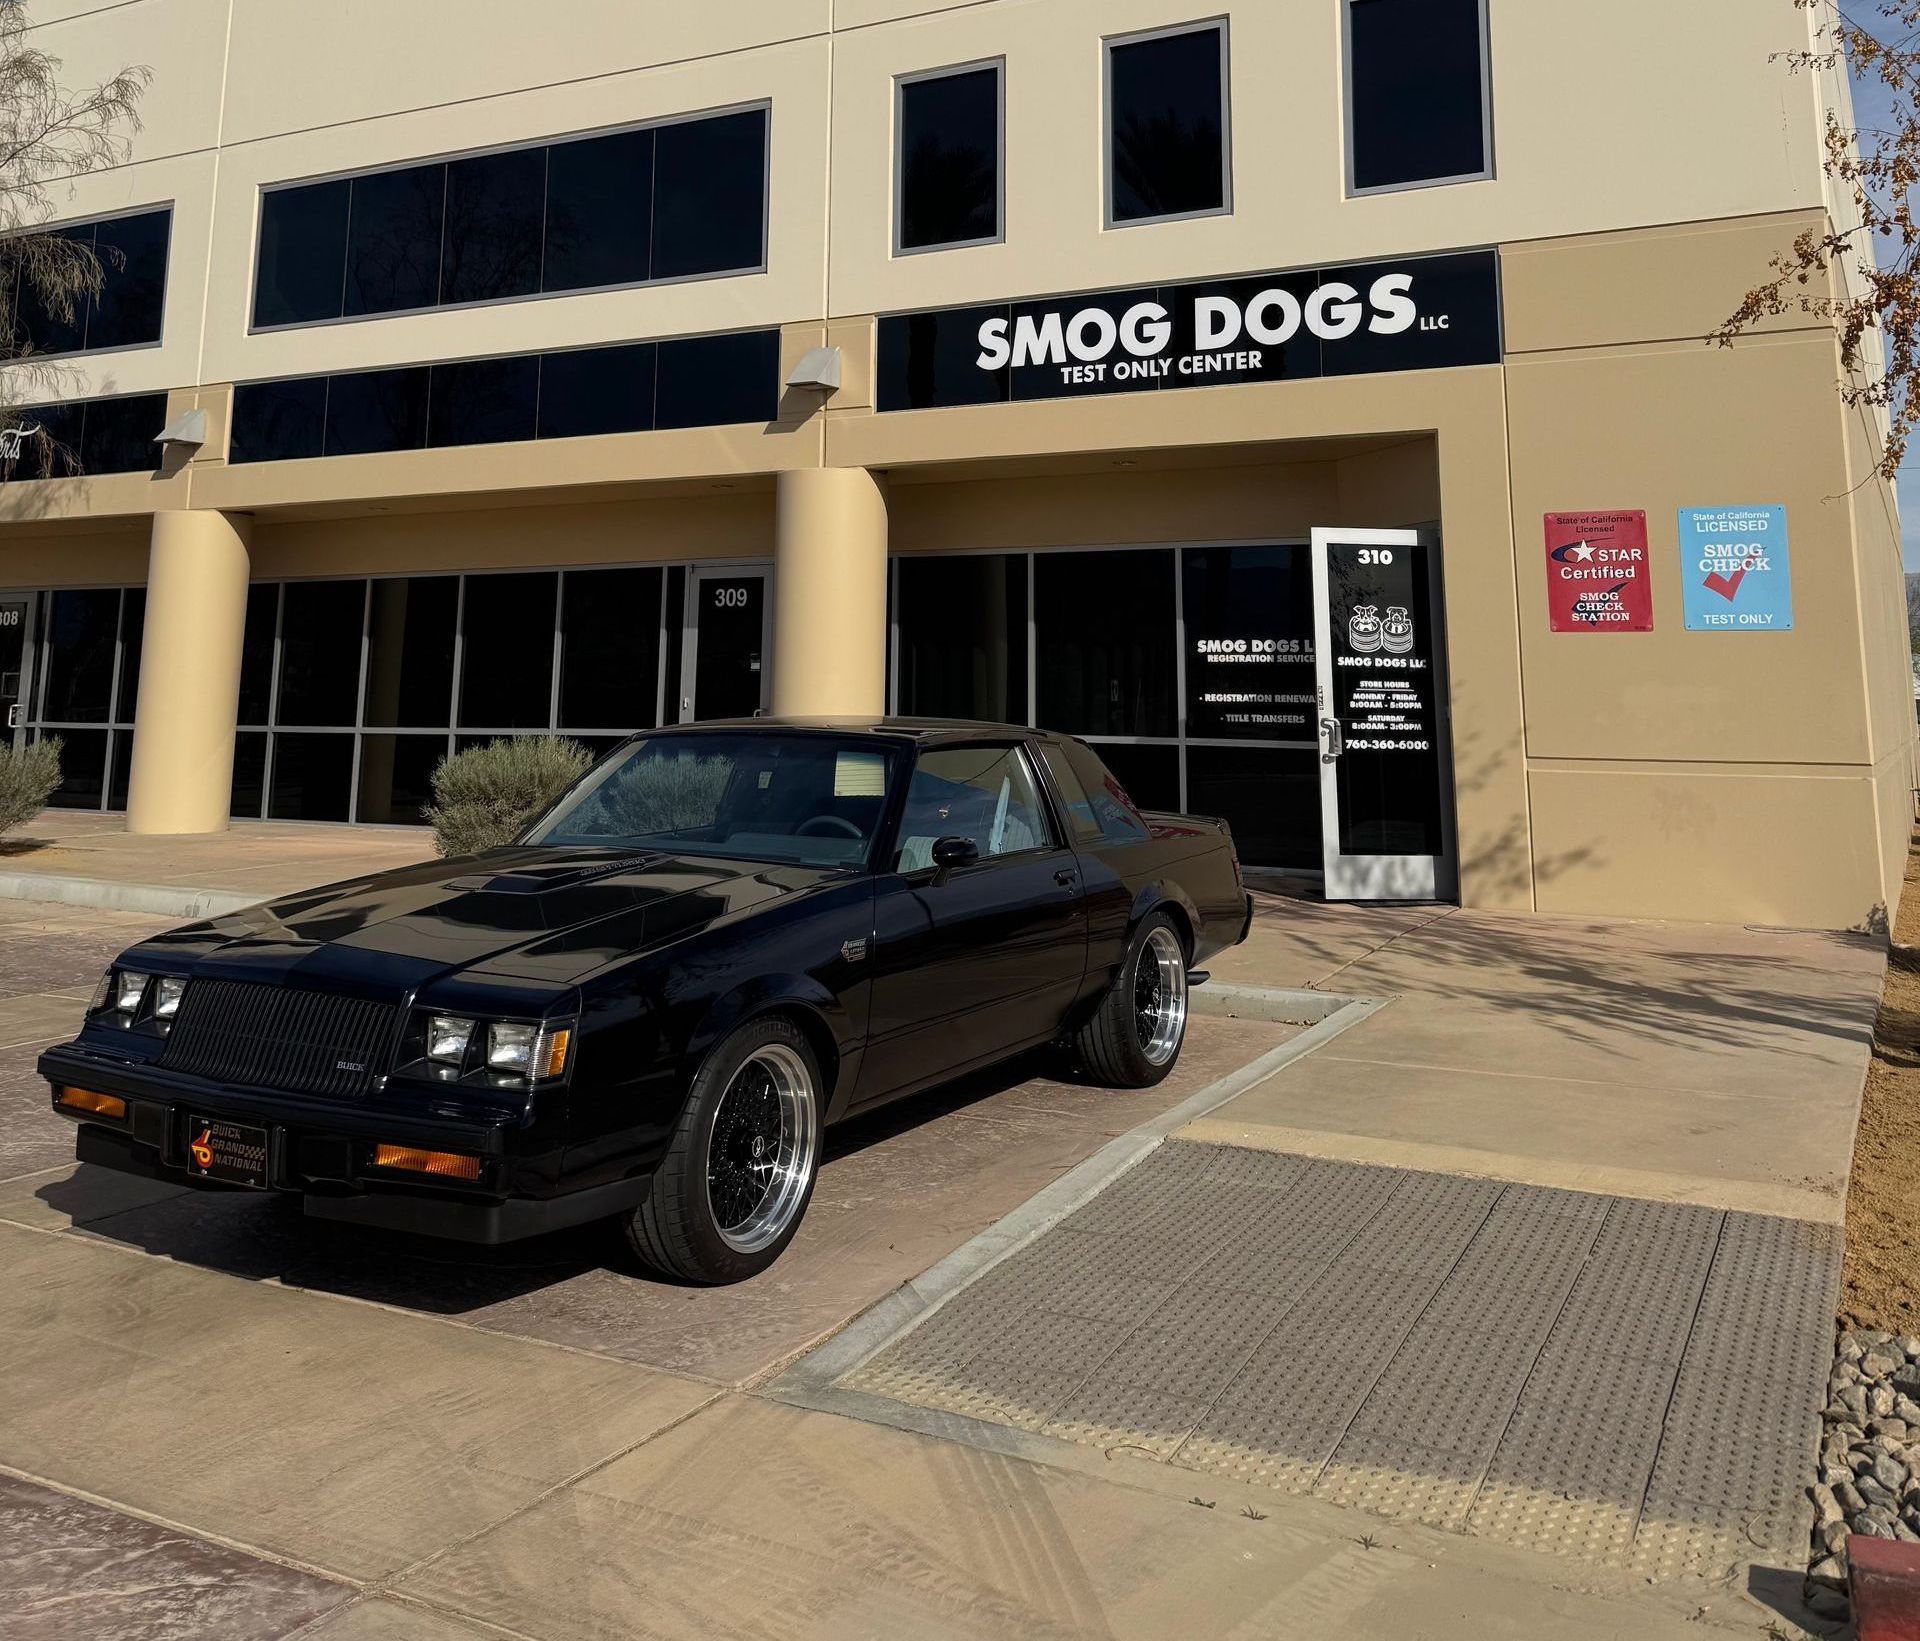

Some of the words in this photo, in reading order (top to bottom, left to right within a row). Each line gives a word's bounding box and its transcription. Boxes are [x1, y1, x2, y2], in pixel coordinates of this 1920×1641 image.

[976, 302, 1172, 370] SMOG
[1194, 274, 1416, 351] DOGS
[1420, 315, 1450, 330] LLC
[1061, 364, 1106, 384] TEST
[1114, 358, 1173, 381] ONLY
[1178, 350, 1262, 375] CENTER
[1556, 516, 1578, 525] State
[1580, 516, 1590, 524] of
[1591, 514, 1633, 523] California
[1693, 513, 1715, 521] State
[1717, 512, 1726, 520] of
[1728, 511, 1770, 520] California
[1576, 524, 1614, 533] Licensed
[1696, 520, 1768, 533] LICENSED
[1598, 549, 1643, 562] STAR
[1704, 543, 1764, 558] SMOG
[1358, 550, 1393, 565] 310
[1698, 558, 1771, 572] CHECK
[1560, 567, 1636, 580] Certified
[715, 588, 747, 607] 309
[1580, 592, 1619, 601] SMOG
[1576, 602, 1624, 612] CHECK
[1572, 612, 1630, 622] STATION
[1704, 614, 1735, 625] TEST
[1738, 614, 1773, 625] ONLY
[1197, 640, 1247, 653] SMOG
[1252, 640, 1299, 653] DOGS
[1207, 655, 1274, 663] REGISTRATION
[1337, 656, 1372, 666] SMOG
[1375, 657, 1407, 667] DOGS
[1410, 659, 1426, 668] LLC
[1205, 694, 1272, 703] REGISTRATION
[1226, 714, 1249, 722] TITLE
[1251, 715, 1305, 723] TRANSFERS
[1345, 740, 1429, 750] 760-360-6000
[336, 1061, 365, 1071] BUICK
[212, 1124, 241, 1140] BUICK
[211, 1139, 246, 1156] GRAND
[214, 1153, 263, 1172] NATIONAL
